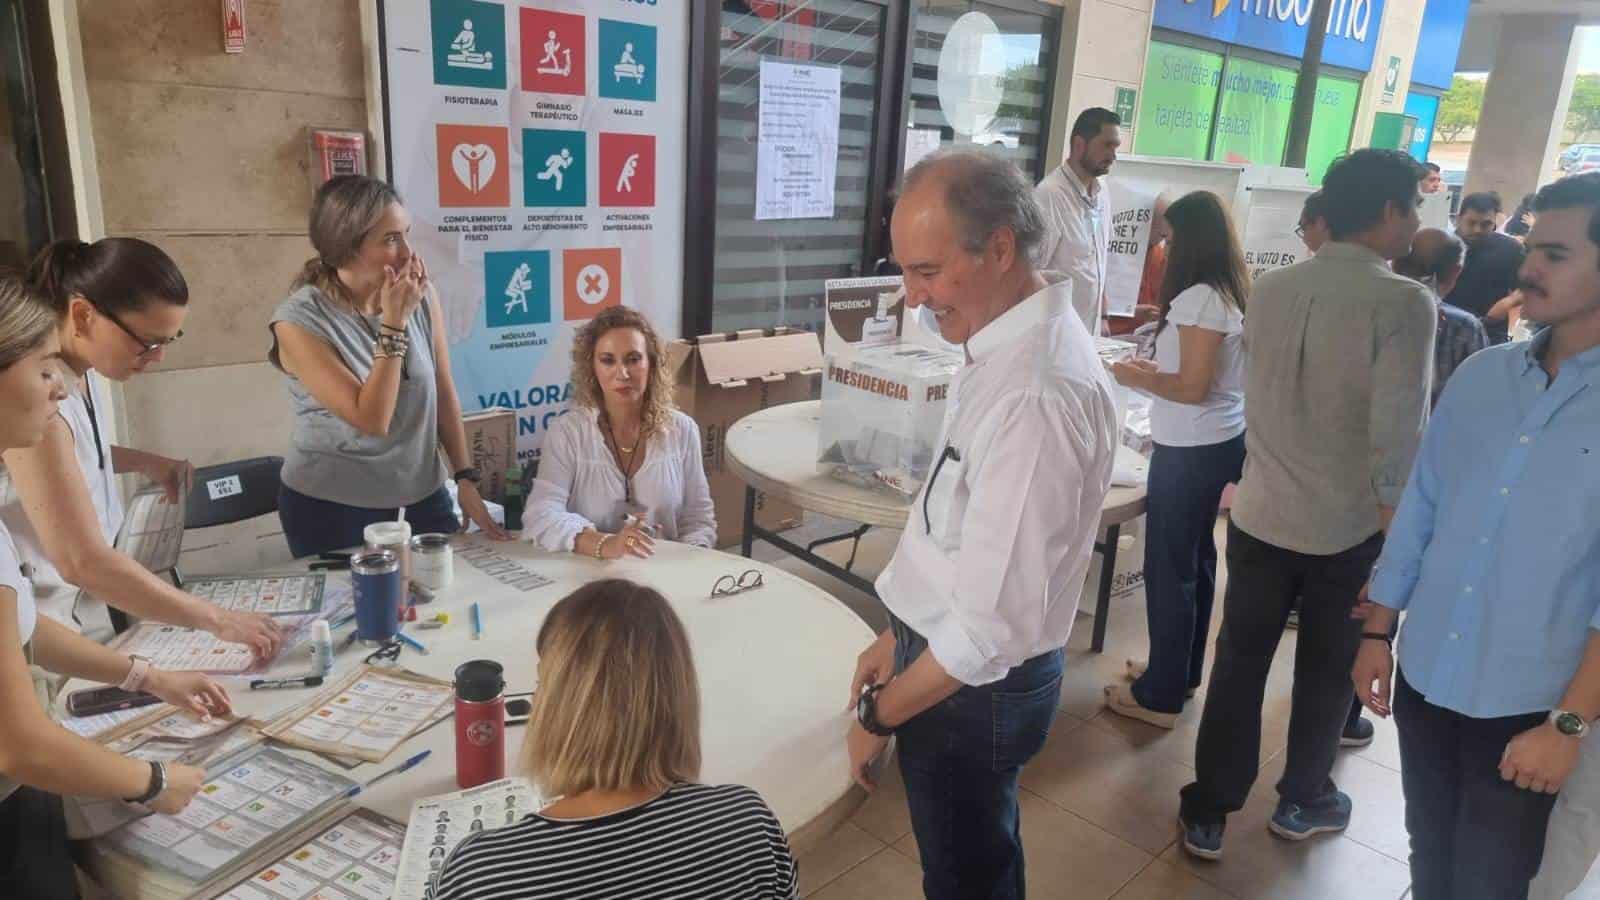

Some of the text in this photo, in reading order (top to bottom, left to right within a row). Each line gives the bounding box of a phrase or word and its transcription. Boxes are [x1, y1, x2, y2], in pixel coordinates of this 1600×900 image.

[444, 95, 498, 107] FISIOTERAPIA
[536, 102, 572, 112] GIMNASIO
[613, 107, 644, 117] MASAJES
[530, 111, 578, 122] TERAPÉUTICO
[443, 215, 507, 224] COMPLEMENTOS
[527, 215, 573, 223] DEPORTISTAS
[606, 213, 650, 222] ACTIVACIONES
[1136, 208, 1151, 223] ES
[438, 225, 461, 233] PARA
[472, 224, 513, 232] BIENESTAR
[523, 223, 588, 231] ALTO RENDIMIENTO
[602, 223, 653, 232] EMPRESARIALES
[1130, 225, 1138, 238] Y
[1256, 252, 1279, 265] VOTO
[1280, 253, 1296, 266] ES
[830, 298, 872, 312] PRESIDENCIA
[489, 338, 548, 351] EMPRESARIALES
[828, 366, 909, 401] PRESIDENCIA
